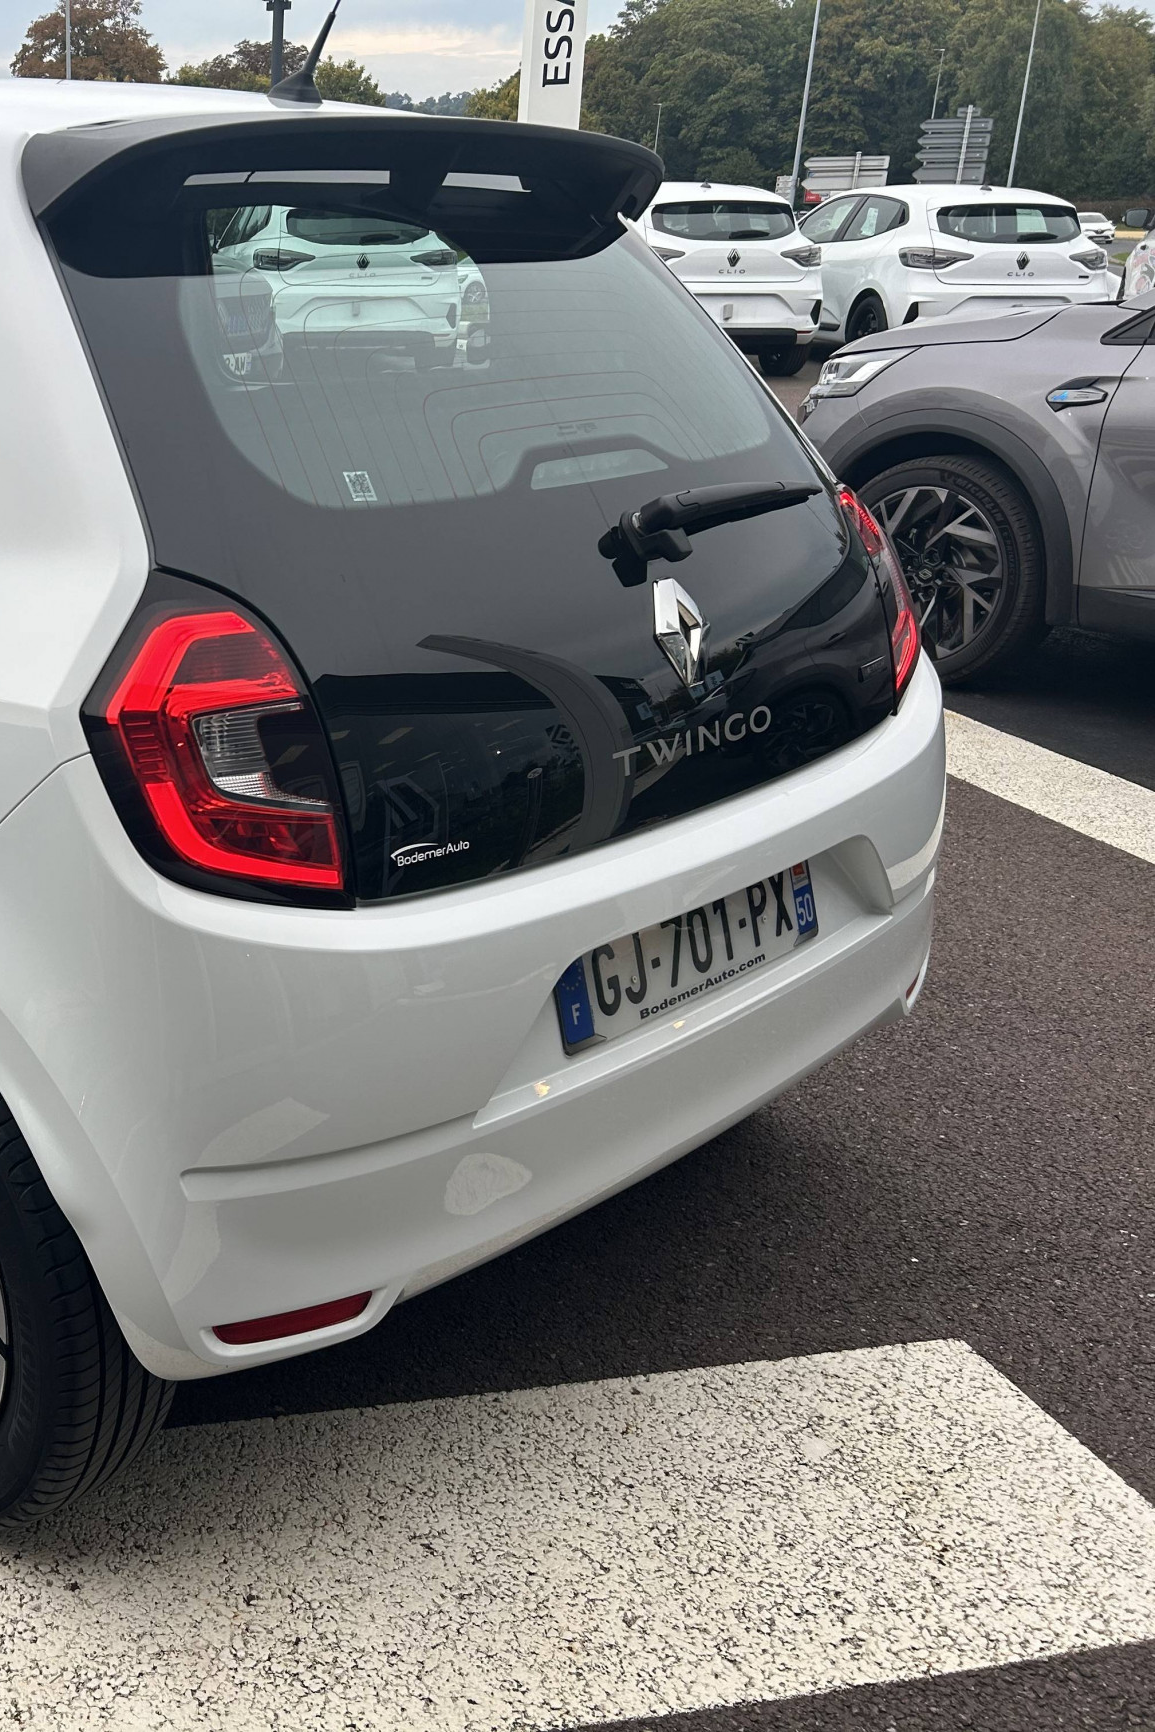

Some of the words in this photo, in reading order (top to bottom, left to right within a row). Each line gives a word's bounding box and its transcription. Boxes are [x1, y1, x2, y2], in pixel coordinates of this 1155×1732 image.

[612, 705, 772, 776] TWINGO
[397, 841, 470, 867] BodemerAuto
[796, 892, 815, 926] 50
[592, 869, 794, 1016] GJ-701-PX
[639, 953, 767, 1020] BodemerAuto.com
[571, 1002, 581, 1025] F
